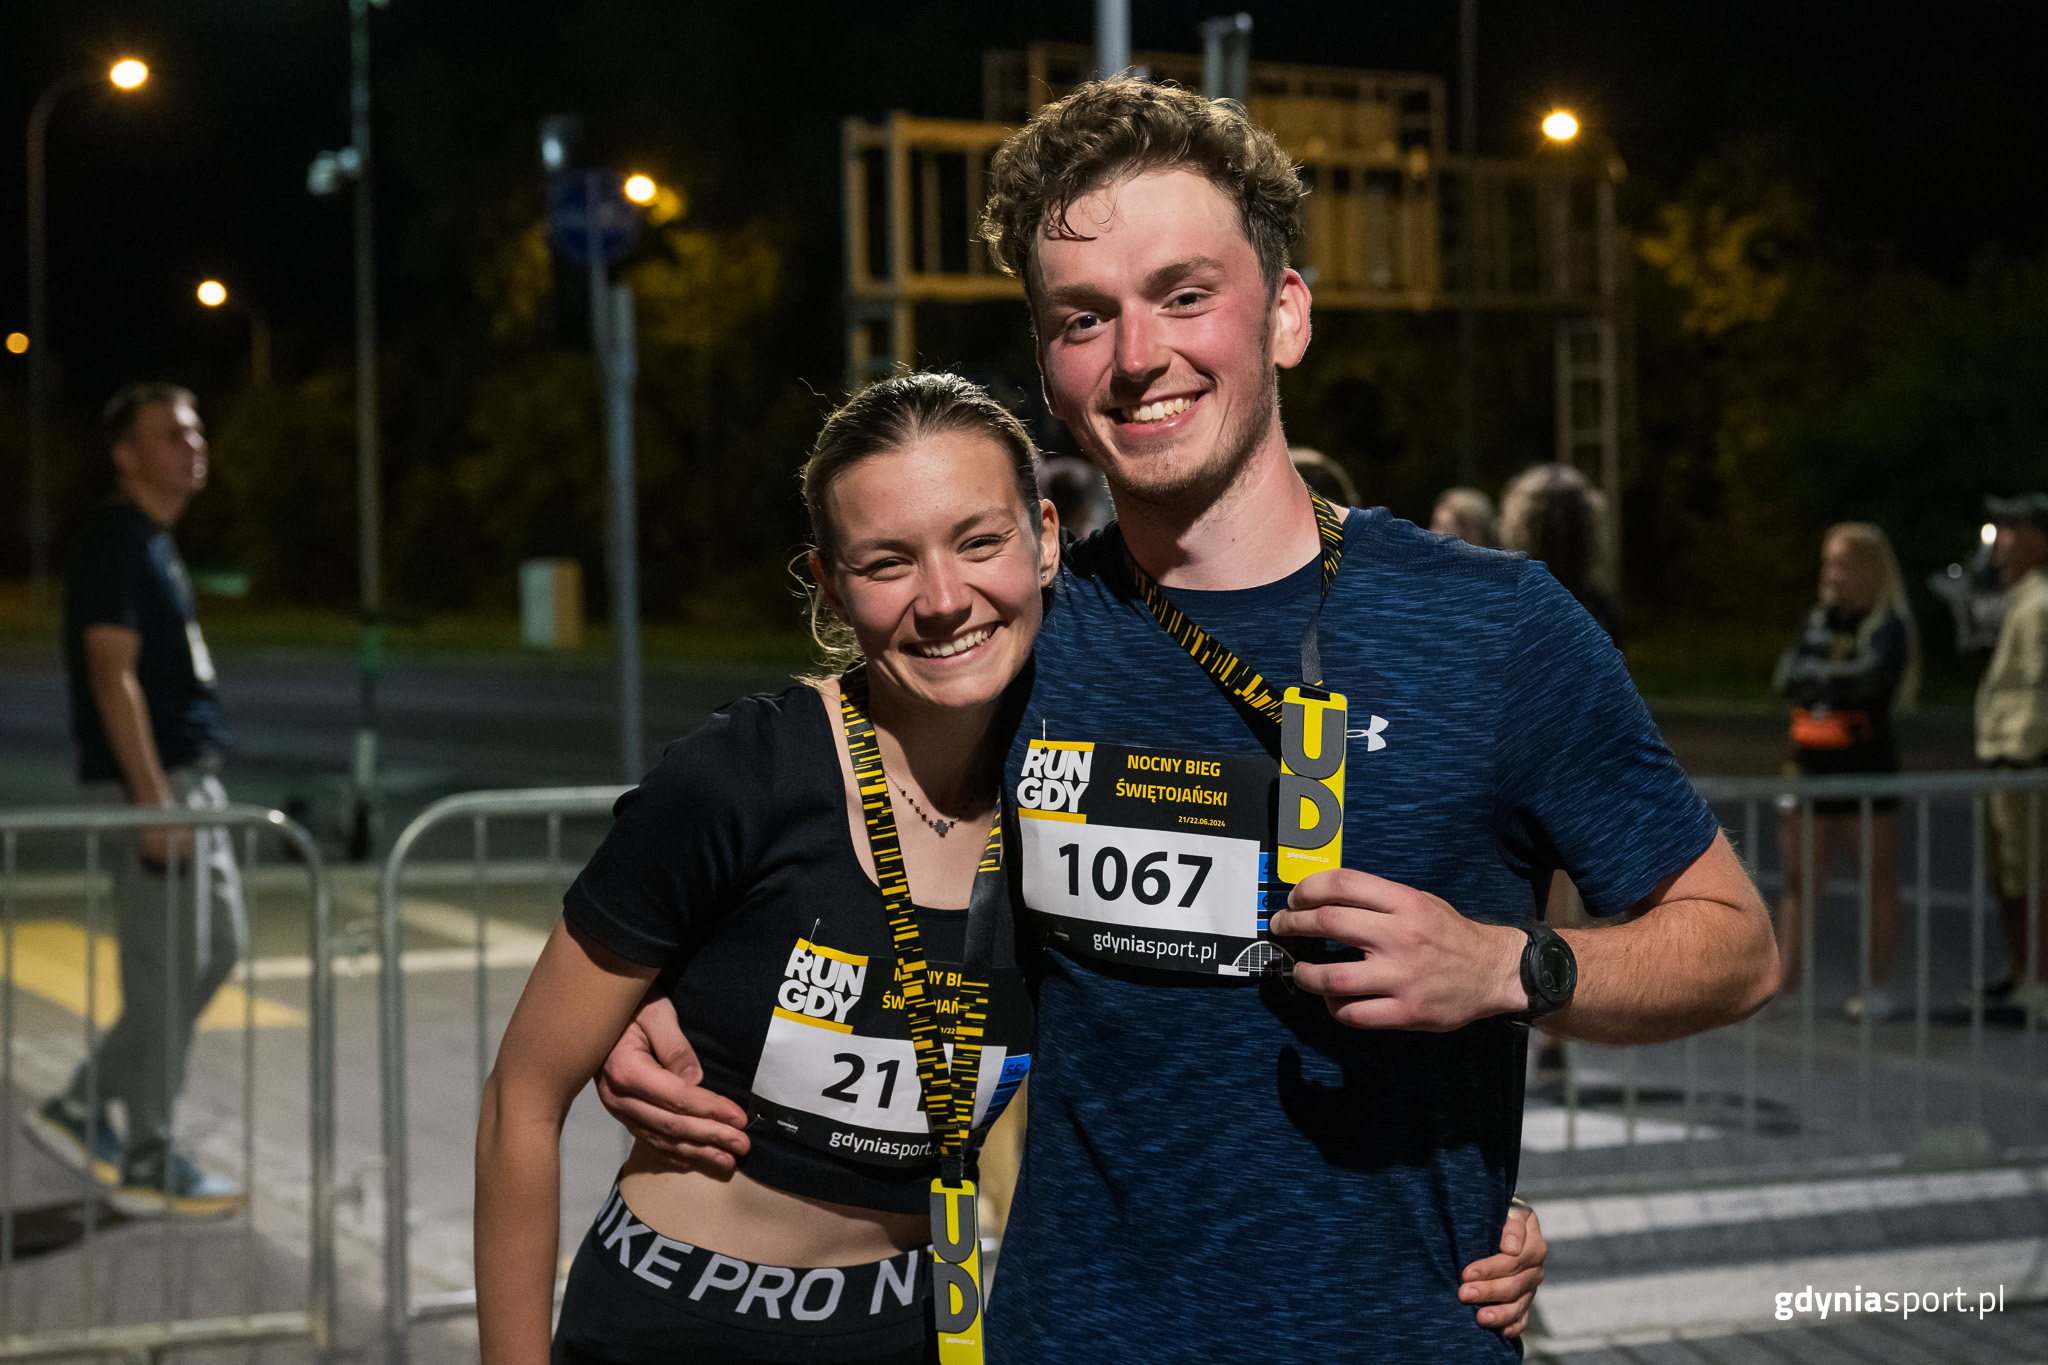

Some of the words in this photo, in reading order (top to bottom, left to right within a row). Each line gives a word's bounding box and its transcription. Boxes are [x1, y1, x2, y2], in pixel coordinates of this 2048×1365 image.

[1020, 748, 1094, 783] RUN
[1127, 754, 1182, 772] NOCNY
[1185, 759, 1221, 777] BIEG
[1017, 777, 1089, 814] GDY
[1115, 778, 1228, 807] ŚWIĘTOJAŃSKI
[1178, 815, 1226, 828] 21/22.06.2024
[1058, 843, 1213, 908] 1067
[1093, 932, 1218, 963] gdyniasport.pl
[784, 947, 868, 996] RUN
[777, 979, 861, 1024] GDY
[821, 1053, 927, 1111] 21
[688, 1253, 845, 1321] PRO
